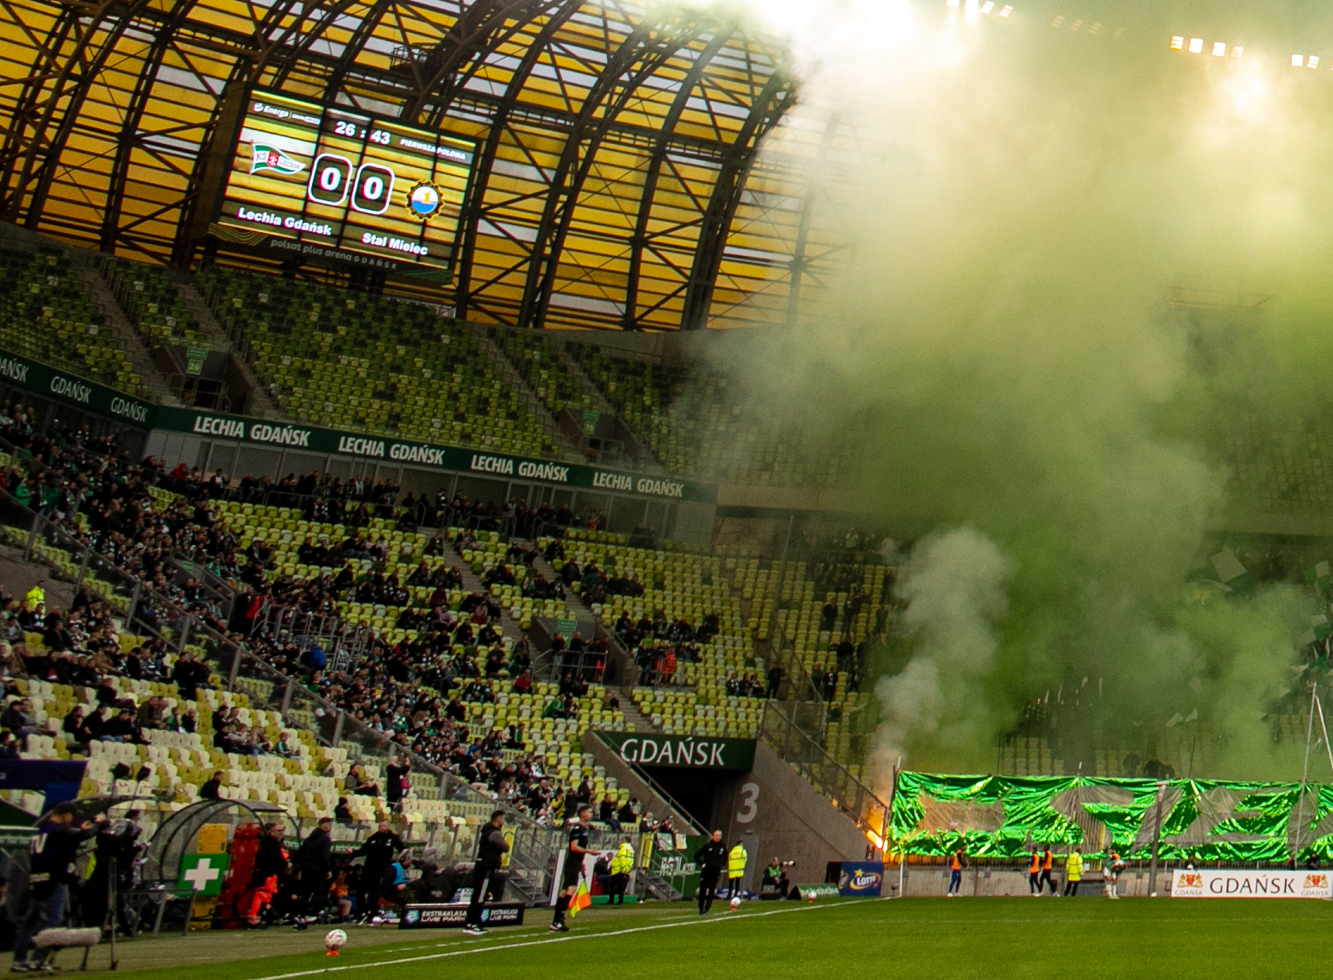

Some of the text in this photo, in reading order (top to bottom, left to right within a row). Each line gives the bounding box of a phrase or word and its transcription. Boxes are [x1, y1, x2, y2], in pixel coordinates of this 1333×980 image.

[334, 121, 356, 136] 26
[371, 129, 392, 145] 43
[400, 138, 436, 152] PIERWSZA
[320, 167, 342, 191] 0
[363, 177, 384, 200] 0
[238, 207, 332, 236] Lechia Gdańsk
[270, 238, 302, 253] polsat
[303, 245, 324, 257] plus
[325, 250, 353, 263] arena
[362, 232, 429, 256] Stal Mielec
[50, 375, 92, 404] GDAŃSK
[110, 397, 148, 423] GDAŃSK
[193, 415, 312, 447] LECHIA GDAŃSK
[338, 435, 446, 466] LECHIA GDAŃSK
[470, 454, 569, 483] LECHIA GDAŃSK
[592, 471, 684, 499] LECHIA GDAŃSK
[619, 735, 727, 766] GDAŃSK
[736, 782, 760, 824] 3
[856, 876, 877, 886] LOTTO
[1174, 888, 1203, 896] GDAŃSK
[1209, 874, 1295, 894] GDAŃSK
[1301, 888, 1329, 896] GDAŃSK
[421, 909, 468, 917] EKSTRAKLASA
[489, 907, 518, 916] EKSTRAKLASA
